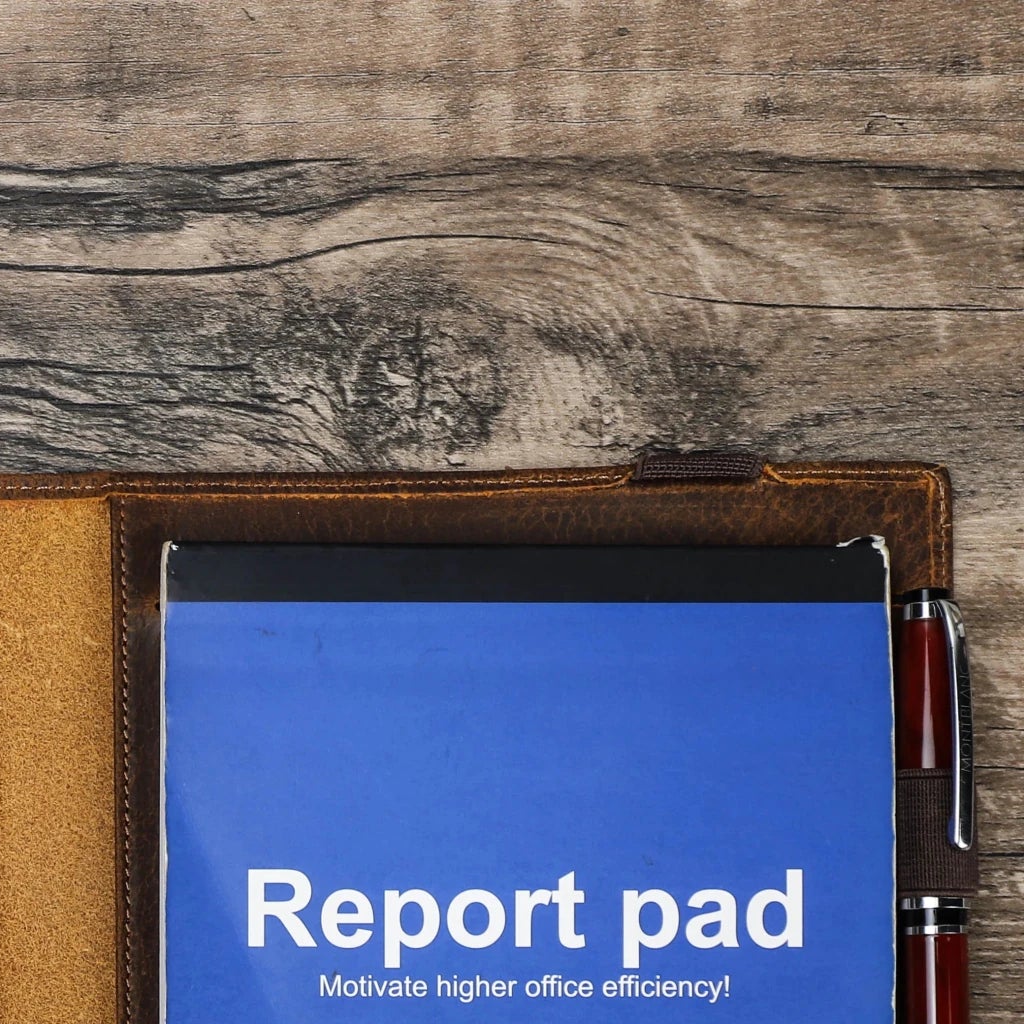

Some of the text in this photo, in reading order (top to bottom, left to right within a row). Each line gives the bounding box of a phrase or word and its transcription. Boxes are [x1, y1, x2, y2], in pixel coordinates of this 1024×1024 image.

[247, 868, 803, 969] Report pad
[319, 975, 730, 1004] Motivate higher office efficiency!
